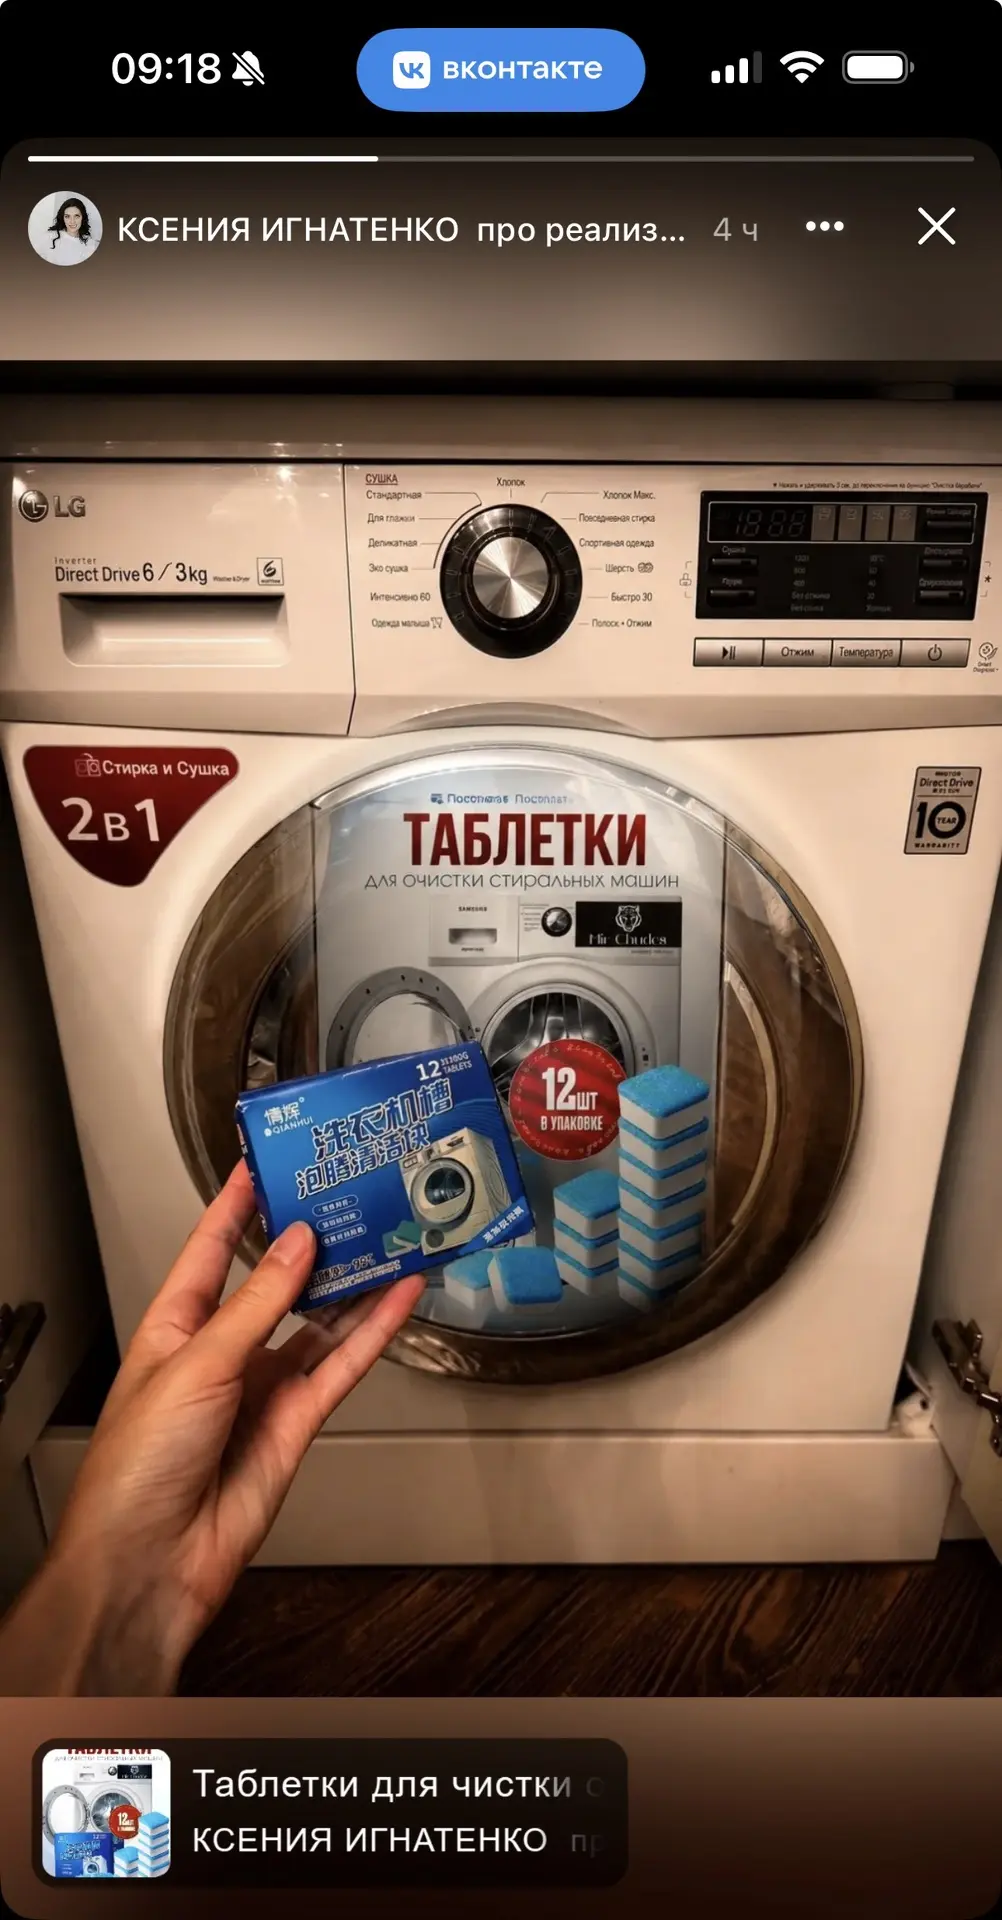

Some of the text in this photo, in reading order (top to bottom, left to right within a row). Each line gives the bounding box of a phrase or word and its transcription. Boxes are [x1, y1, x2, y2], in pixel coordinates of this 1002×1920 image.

[365, 473, 398, 486] СУШКА
[496, 477, 526, 488] Хлопок
[366, 490, 422, 501] Стандартная
[602, 490, 632, 500] Хлопок
[54, 495, 87, 518] LG
[367, 513, 383, 524] Для
[368, 538, 418, 549] Деликатная
[579, 538, 655, 549] Спортивная одежда
[55, 565, 100, 582] Direct
[102, 565, 140, 582] Drive
[368, 563, 409, 575] Эко сушка
[605, 563, 635, 574] Шерсть
[369, 592, 431, 602] Интенсивно 60
[610, 592, 653, 603] Быстро 30
[371, 618, 400, 629] Одежда
[626, 618, 653, 628] Отжим
[780, 646, 815, 658] Отжим
[839, 646, 894, 660] Температура
[102, 760, 230, 780] Стирка и Сушка
[919, 777, 974, 787] Direct Drive
[914, 800, 967, 840] 10
[936, 816, 957, 825] YEAR
[402, 812, 647, 867] ТАБЛЕТКИ
[364, 873, 680, 890] для очистки стиральных машин
[415, 1059, 443, 1082] 12
[311, 1078, 454, 1162] 洗衣机槽
[540, 1115, 604, 1132] В УПАКОВКЕ
